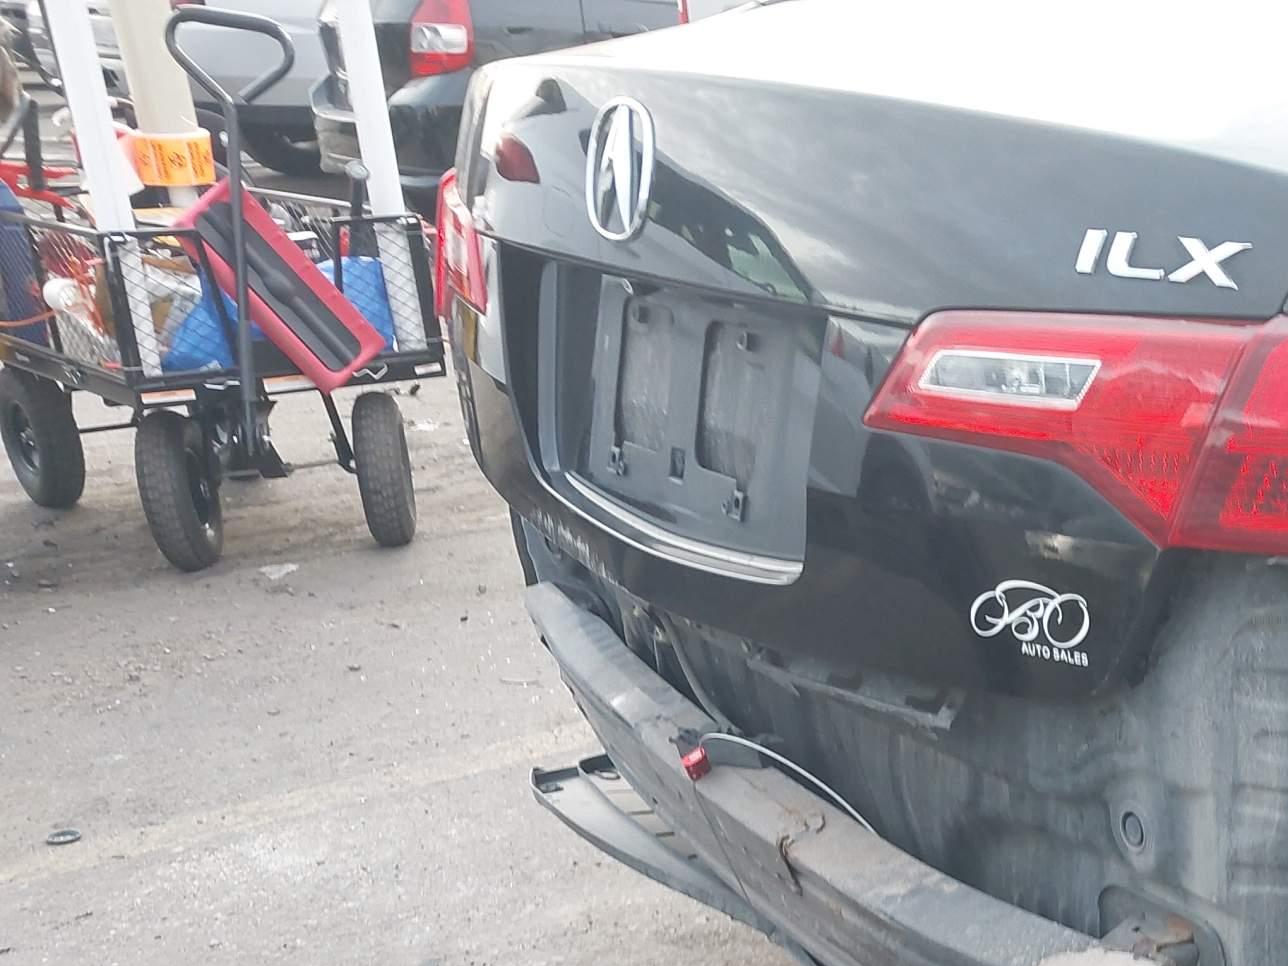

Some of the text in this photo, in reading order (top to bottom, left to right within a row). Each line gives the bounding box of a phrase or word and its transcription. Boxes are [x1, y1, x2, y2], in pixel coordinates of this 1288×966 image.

[1075, 228, 1254, 291] ILX
[1021, 641, 1089, 667] AUTO SALES
